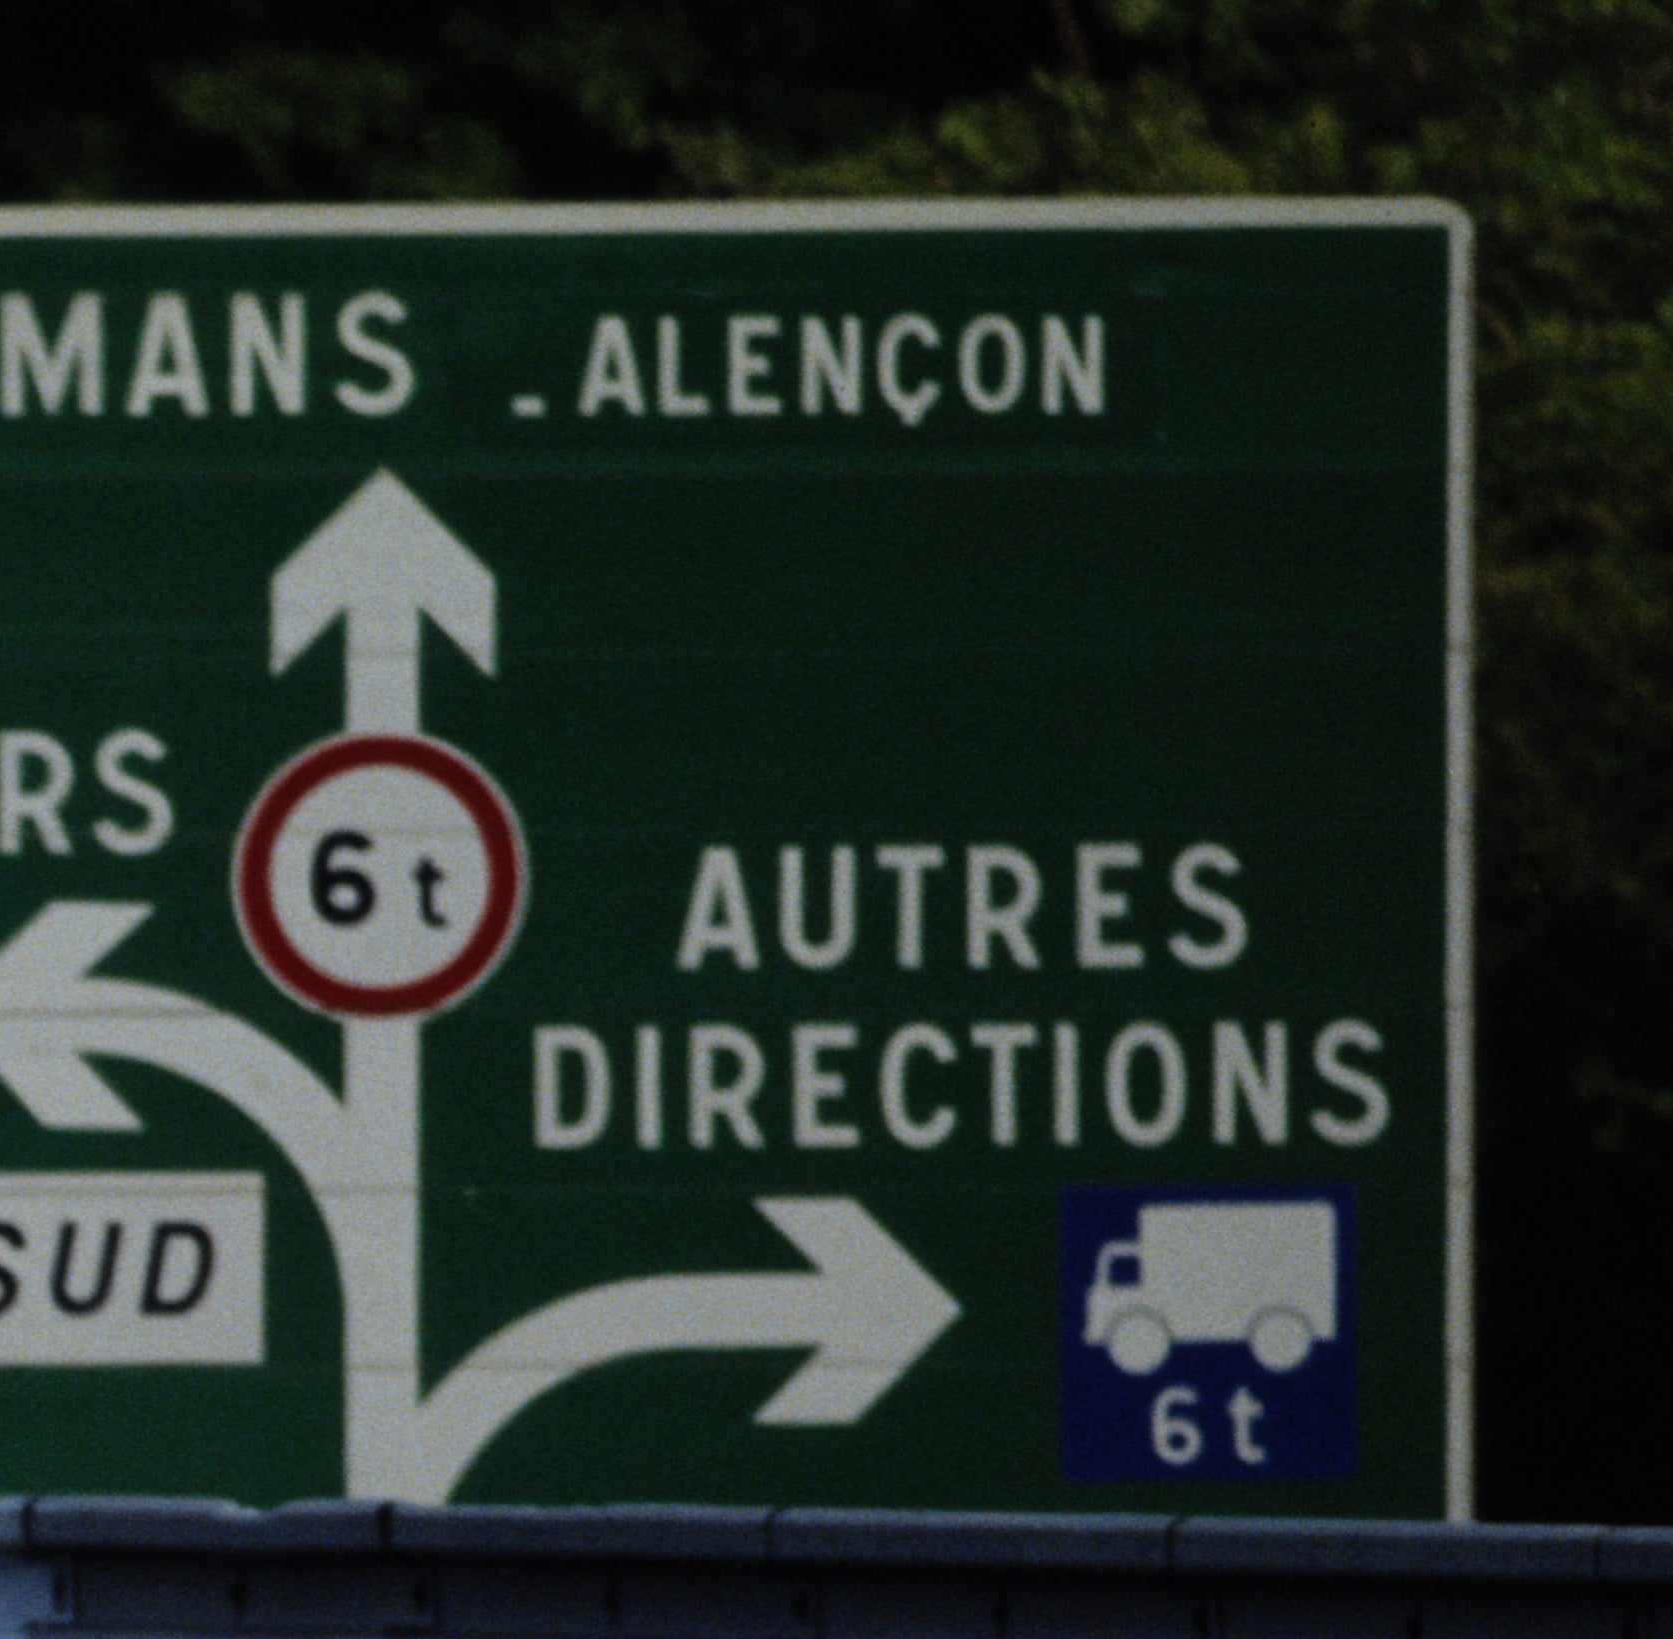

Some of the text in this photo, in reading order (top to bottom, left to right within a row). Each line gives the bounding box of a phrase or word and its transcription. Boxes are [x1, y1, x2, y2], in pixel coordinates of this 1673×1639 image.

[579, 314, 1104, 425] ALENÇON
[677, 844, 1247, 969] AUTRES
[533, 1020, 1391, 1149] DIRECTIONS
